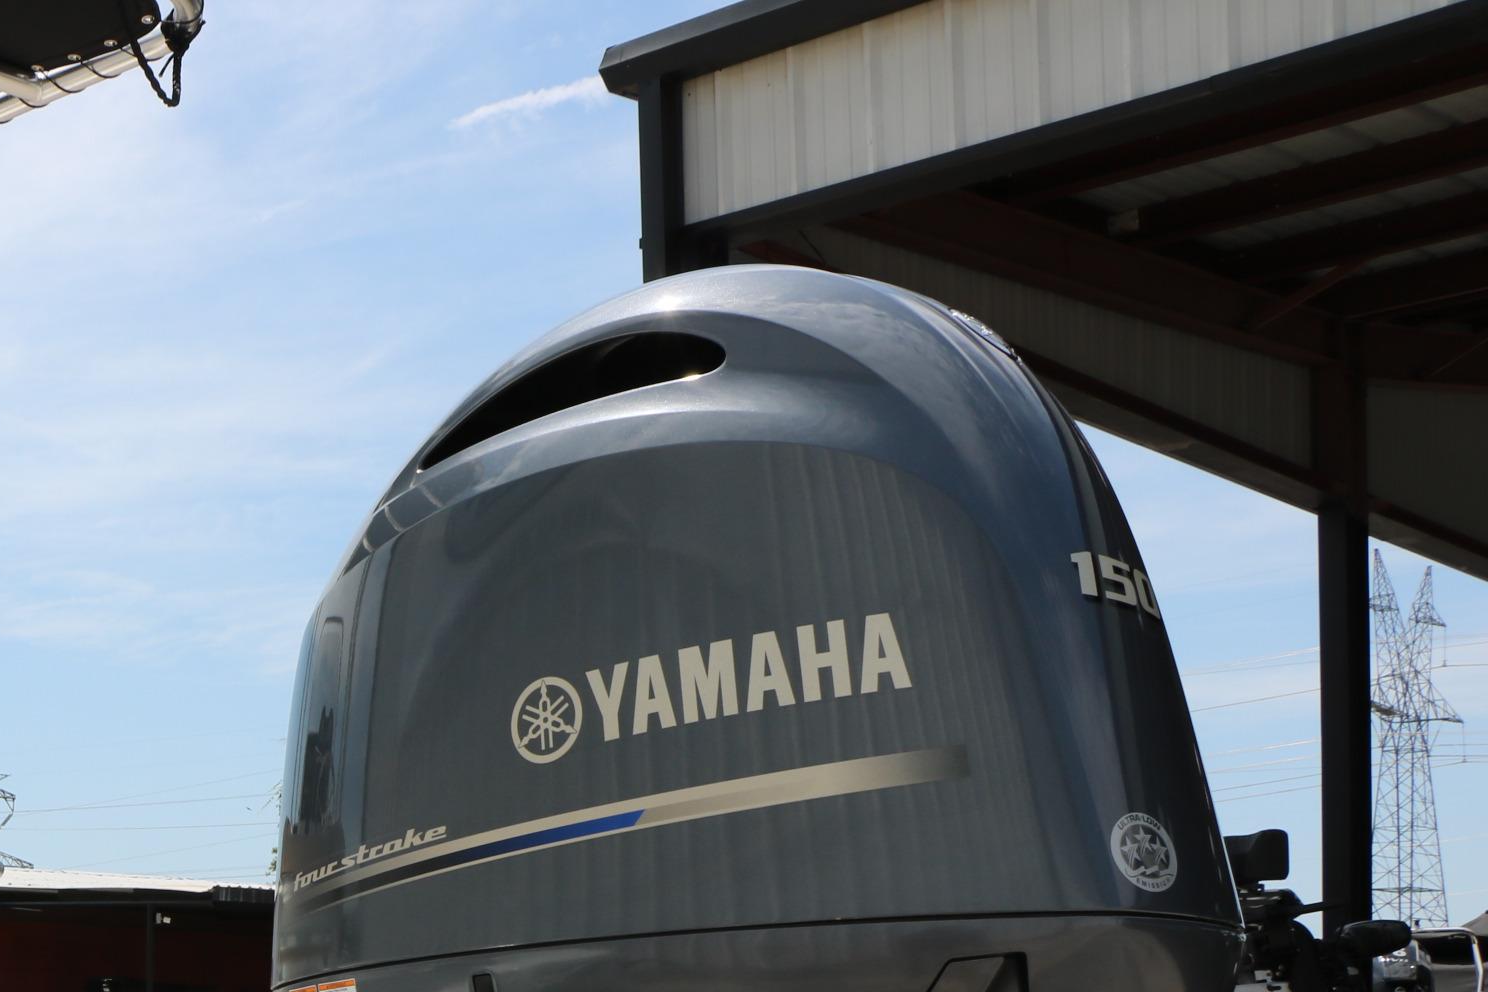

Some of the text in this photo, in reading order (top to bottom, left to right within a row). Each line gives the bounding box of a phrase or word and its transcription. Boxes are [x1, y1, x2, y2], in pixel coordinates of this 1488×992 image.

[1070, 551, 1160, 619] 150
[585, 613, 912, 742] YAMAHA
[1117, 814, 1162, 830] ULTRA LOW
[294, 825, 448, 892] four stroke
